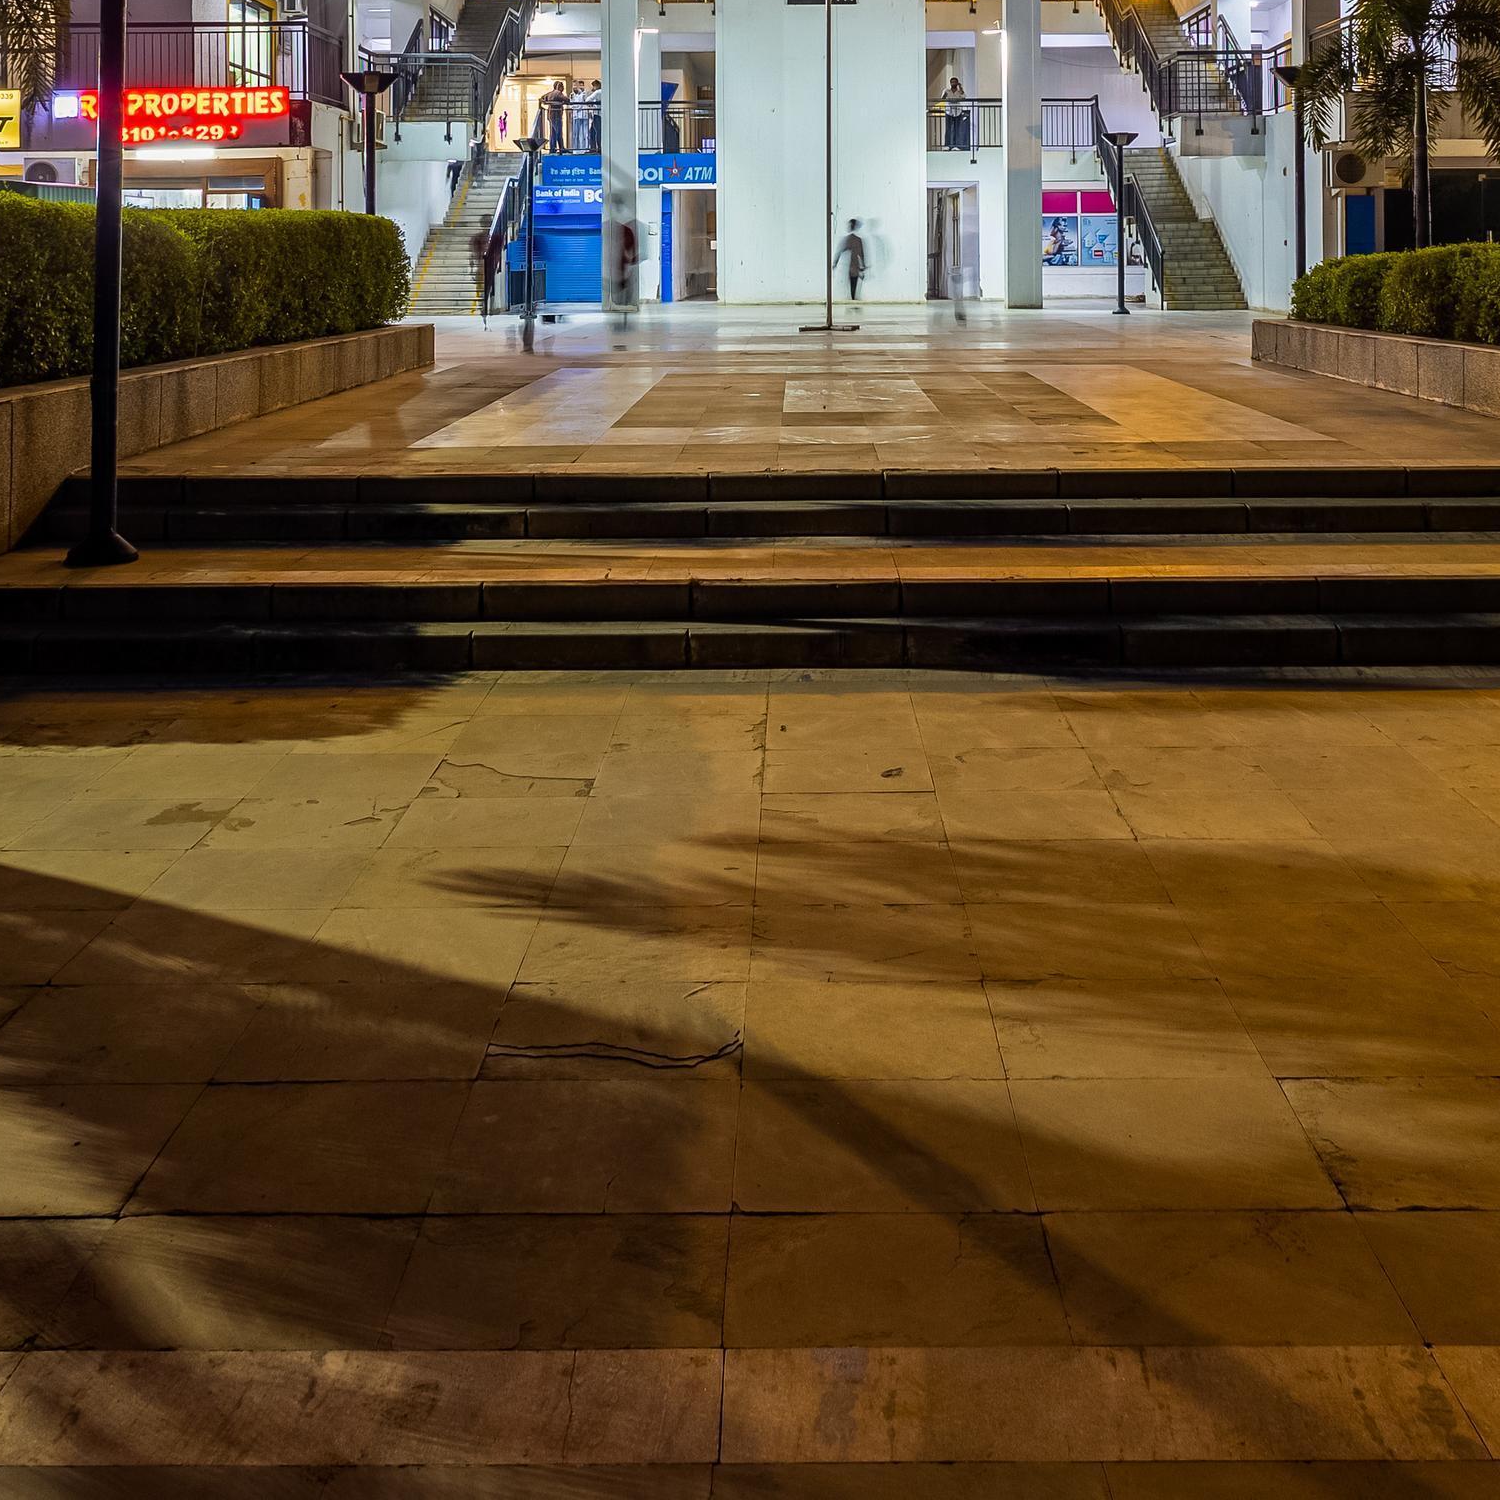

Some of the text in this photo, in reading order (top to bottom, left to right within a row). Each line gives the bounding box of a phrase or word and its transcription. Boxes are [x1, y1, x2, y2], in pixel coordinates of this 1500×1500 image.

[127, 91, 284, 118] PROPERTIES
[684, 166, 713, 181] ATM
[535, 189, 553, 197] Bank
[553, 188, 562, 197] of
